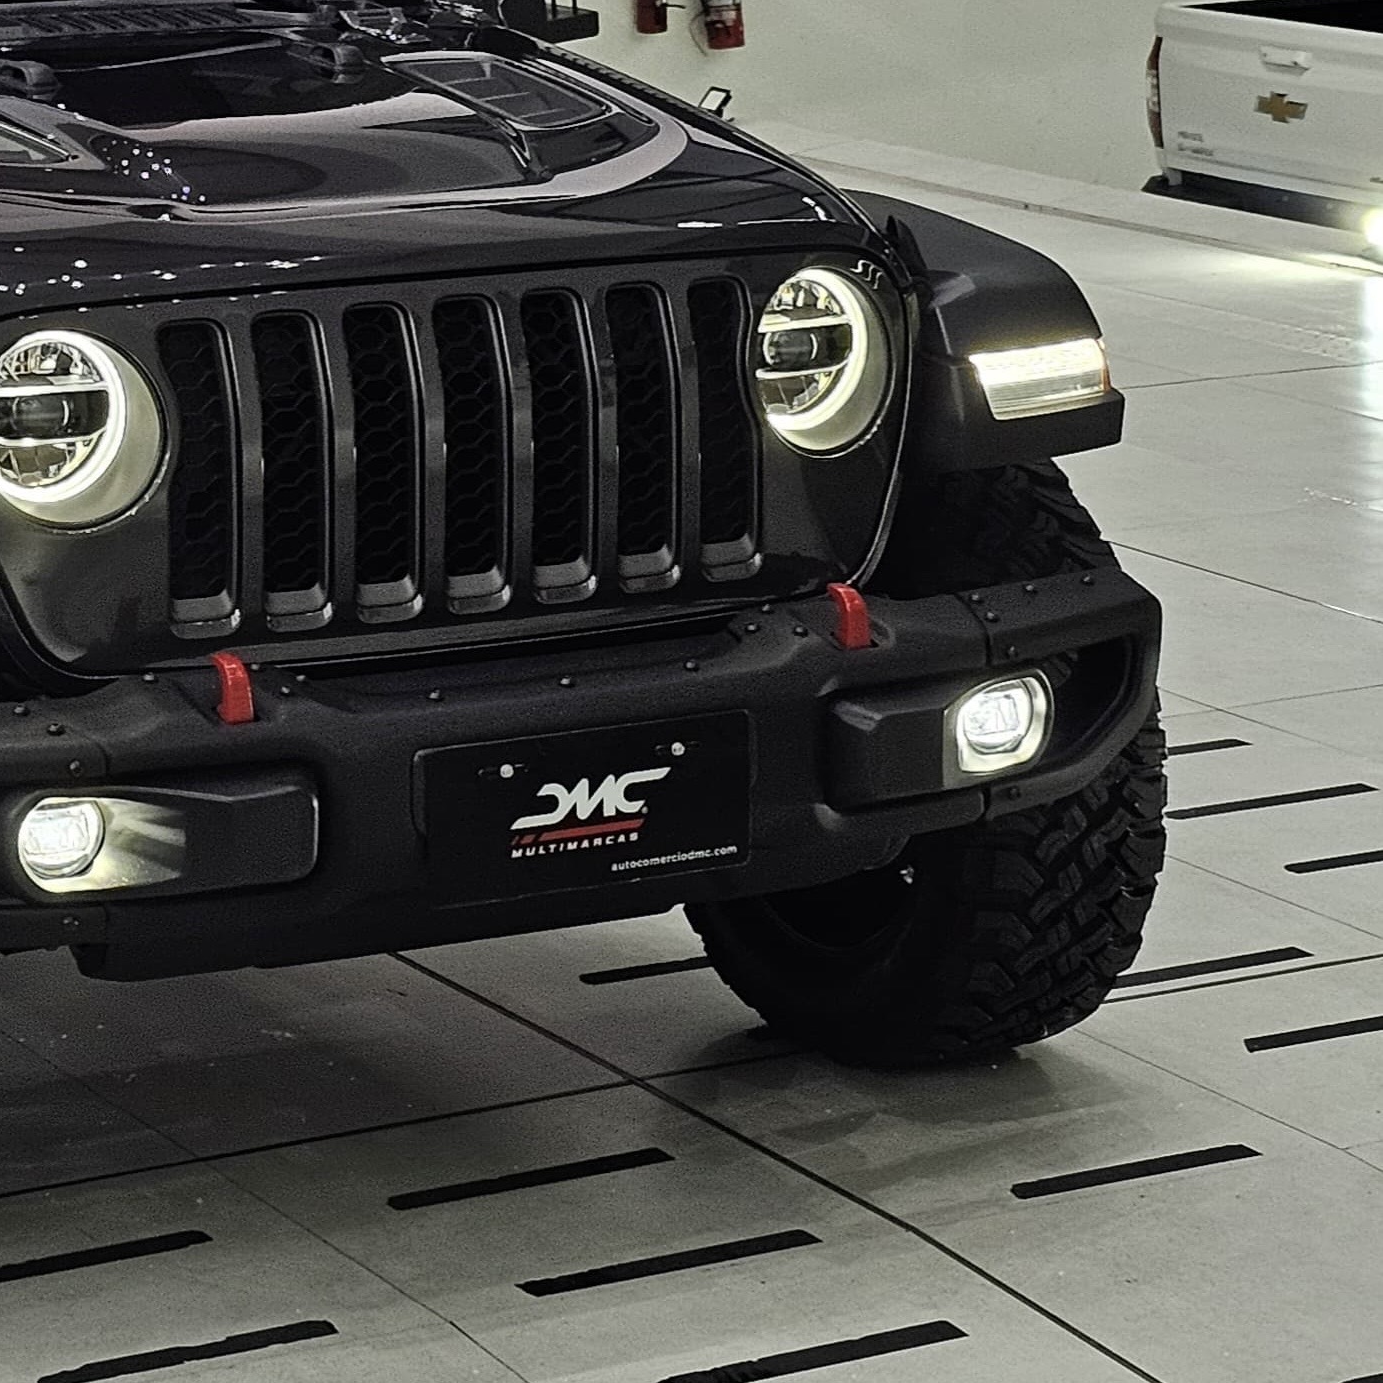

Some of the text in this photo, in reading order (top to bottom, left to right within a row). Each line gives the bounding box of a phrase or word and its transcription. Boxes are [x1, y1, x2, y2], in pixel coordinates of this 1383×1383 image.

[510, 767, 671, 830] DMC
[511, 832, 639, 858] MULTIMARCAS
[611, 845, 737, 871] autocomerciodmc.com
